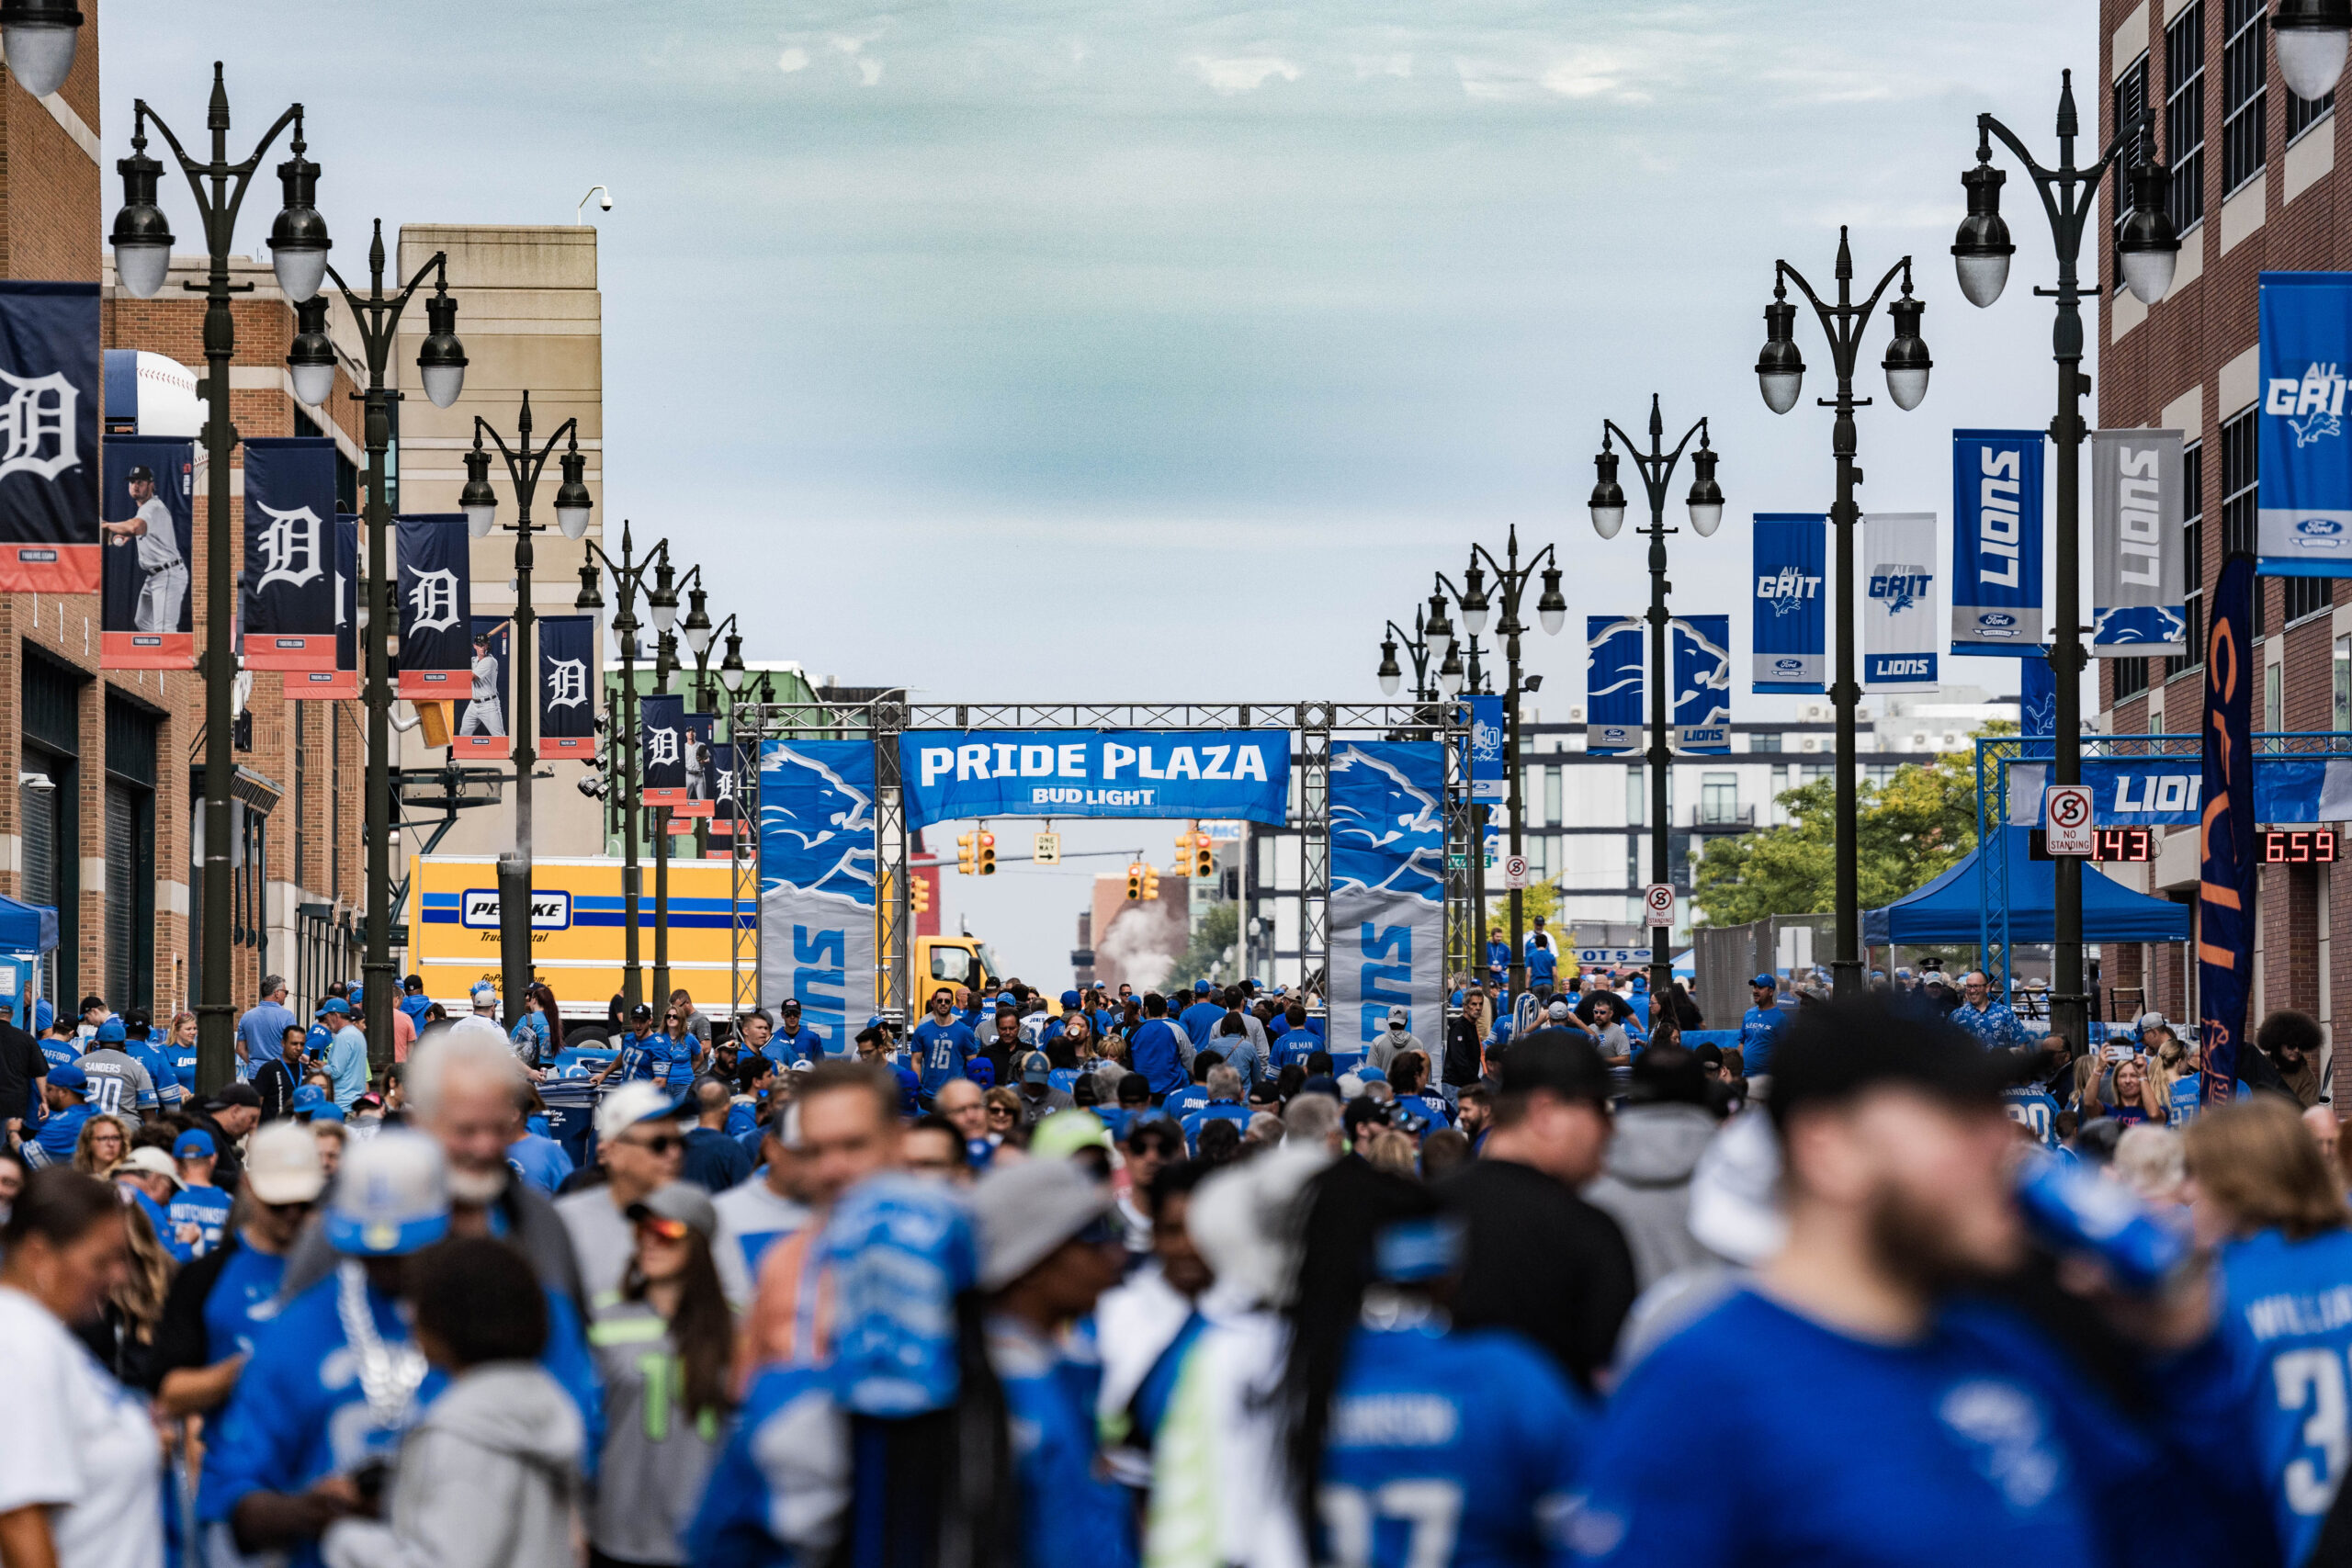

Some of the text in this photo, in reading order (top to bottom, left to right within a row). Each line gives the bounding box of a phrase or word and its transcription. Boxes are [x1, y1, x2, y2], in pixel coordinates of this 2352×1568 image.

[2303, 361, 2345, 382] ALL
[2265, 378, 2352, 416] GRI
[1980, 446, 2020, 589] LIONS
[2120, 446, 2159, 588] LIONS
[2304, 520, 2335, 534] Ford
[1780, 566, 1803, 578] ALL
[1889, 565, 1916, 577] ALL
[1757, 576, 1821, 598] GRIT
[1868, 575, 1933, 598] GRIT
[1985, 614, 2009, 626] Ford
[1780, 660, 1797, 669] Ford
[1876, 659, 1929, 676] LIONS
[1683, 728, 1724, 742] LIONS
[921, 741, 1268, 786] PRIDE PLAZA
[1032, 788, 1155, 806] BUD LIGHT
[2114, 775, 2203, 812] LION
[2064, 830, 2076, 839] NO
[2051, 840, 2089, 850] STANDING
[2266, 833, 2334, 863] 6.59
[470, 903, 561, 917] PEKE
[1616, 950, 1628, 961] 5
[1289, 1042, 1313, 1050] GILMAN
[930, 1039, 953, 1070] 16
[85, 1062, 121, 1074] SANDERS
